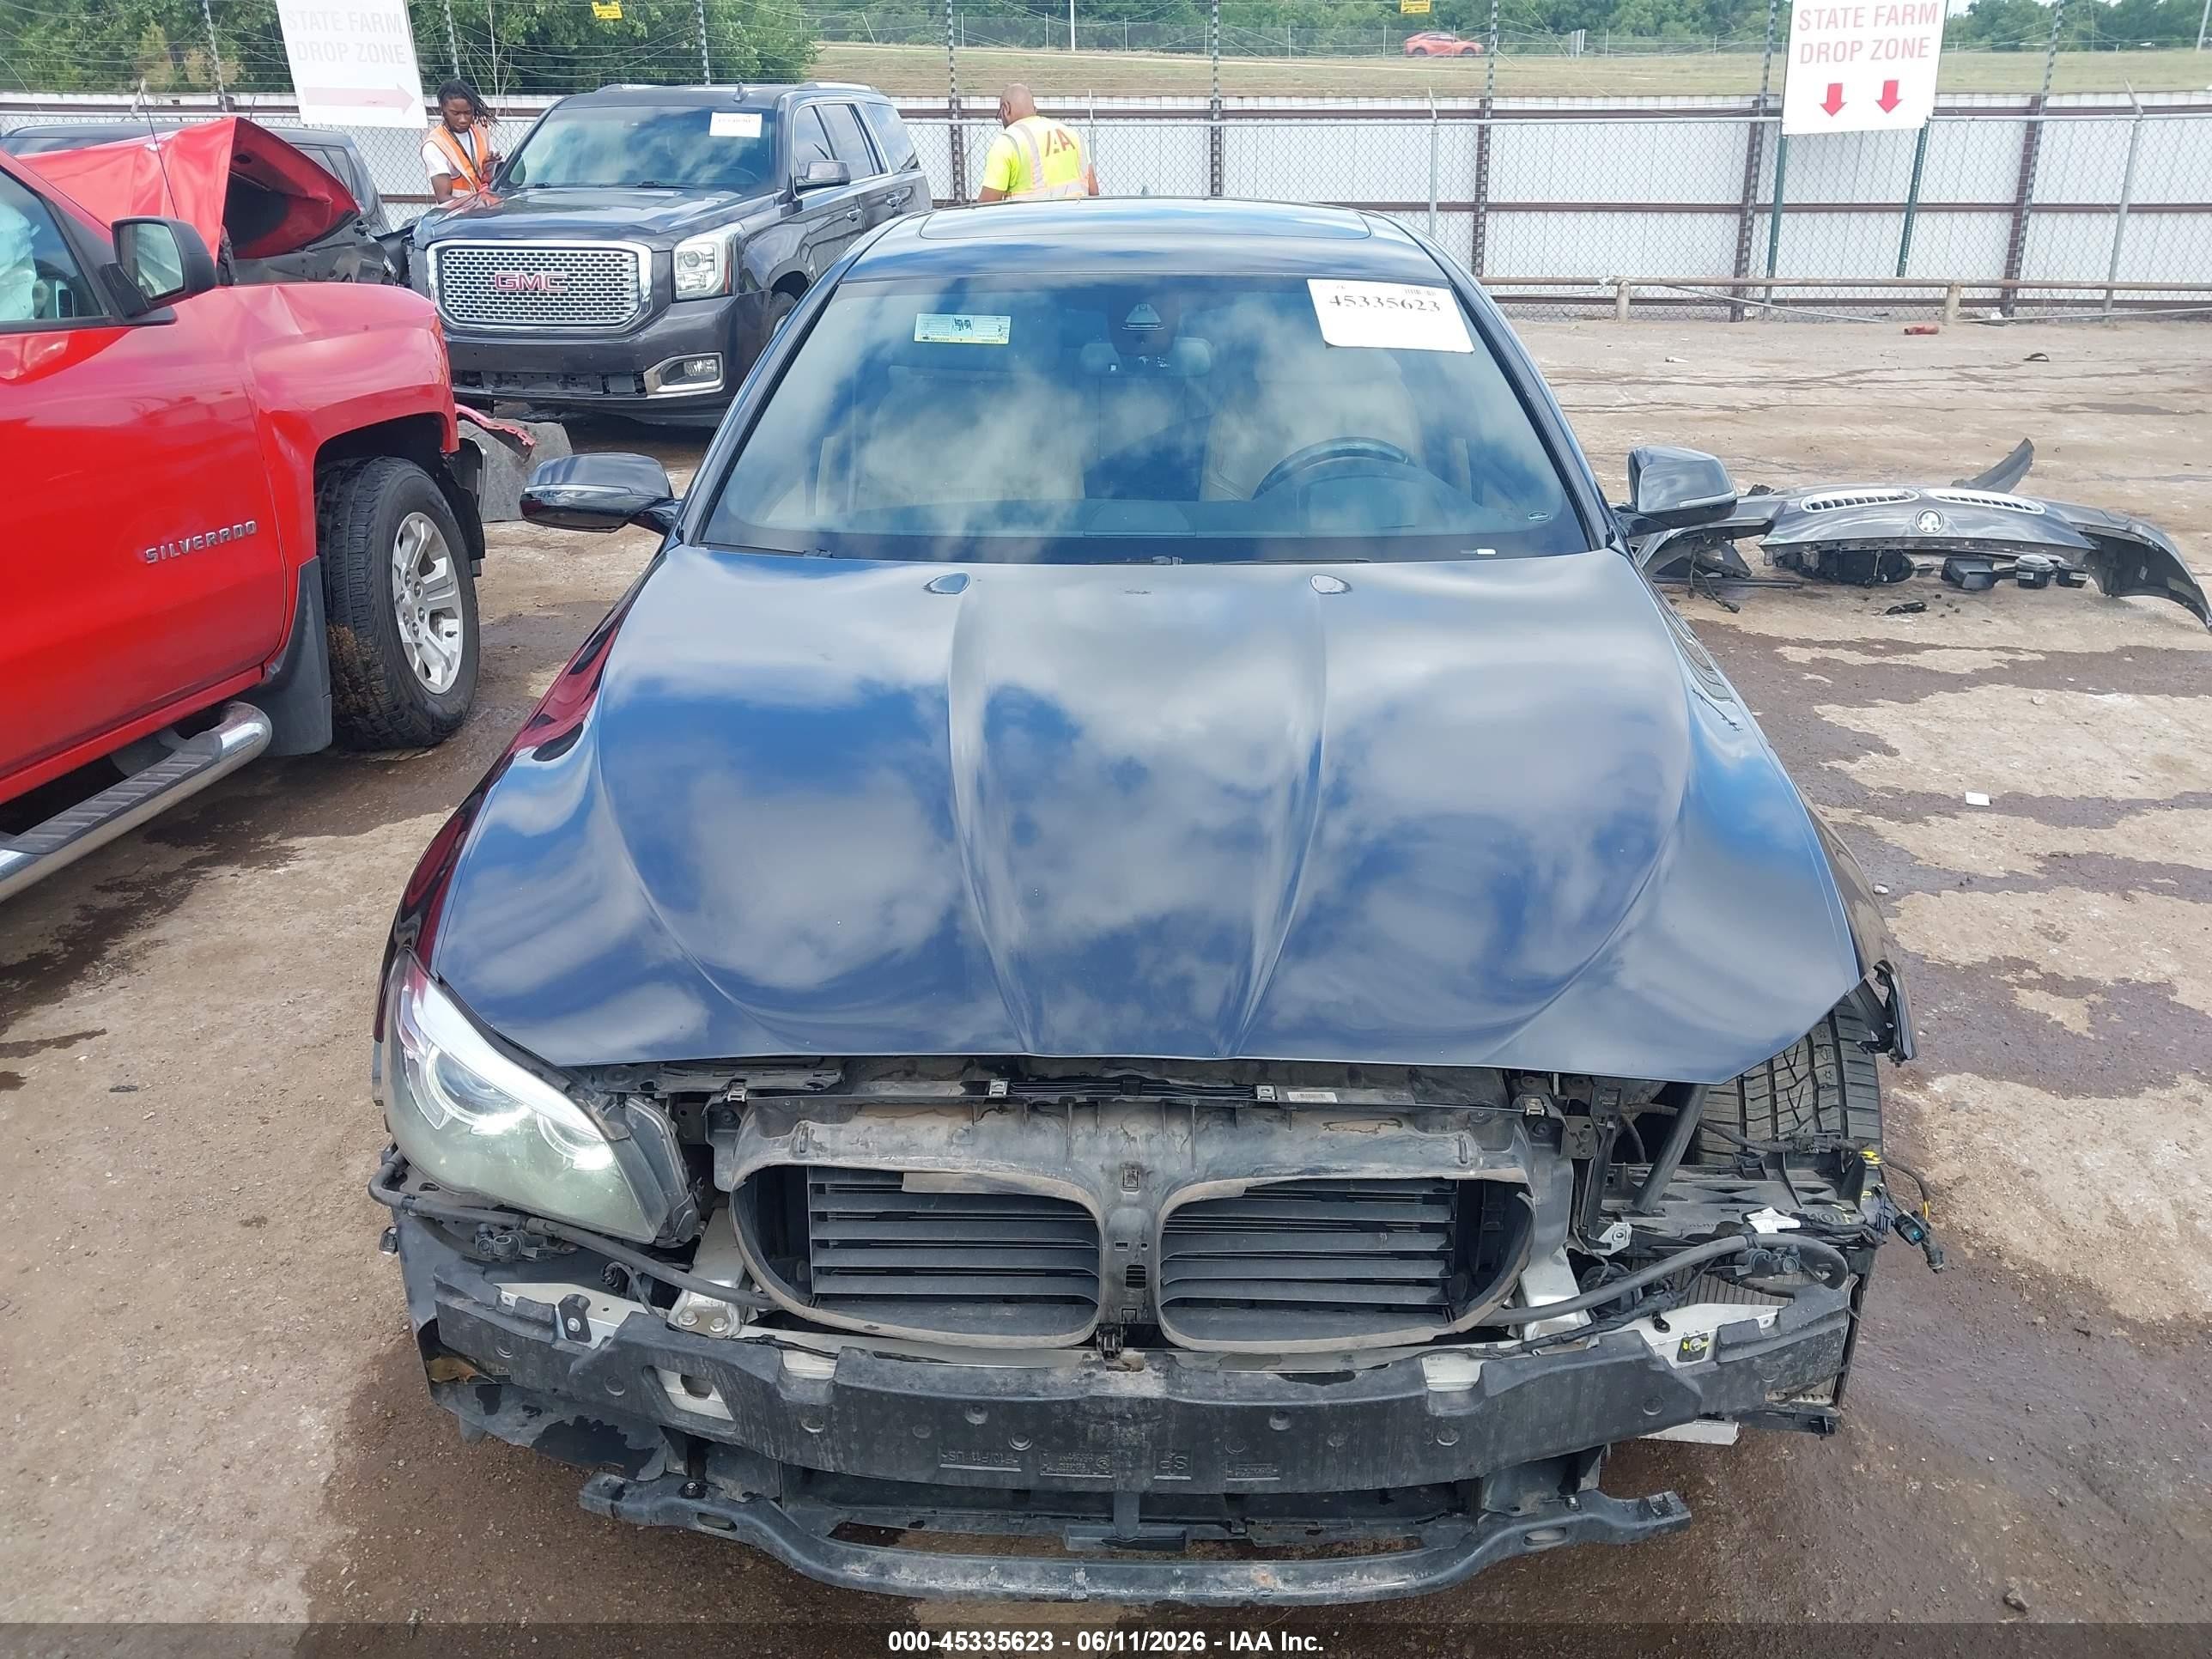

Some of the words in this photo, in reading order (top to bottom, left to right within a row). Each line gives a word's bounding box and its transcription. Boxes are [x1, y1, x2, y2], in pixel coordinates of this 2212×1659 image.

[285, 9, 344, 31] STATE
[347, 11, 404, 34] FARM
[1798, 6, 1865, 32] STATE
[1874, 3, 1938, 27] FARM
[295, 40, 349, 63] DROP
[355, 42, 407, 64] ZONE
[1800, 40, 1863, 64] DROP
[1869, 37, 1931, 61] ZONE
[494, 272, 569, 292] GMC
[1328, 294, 1442, 313] 45335623
[145, 520, 258, 565] SILVERADO
